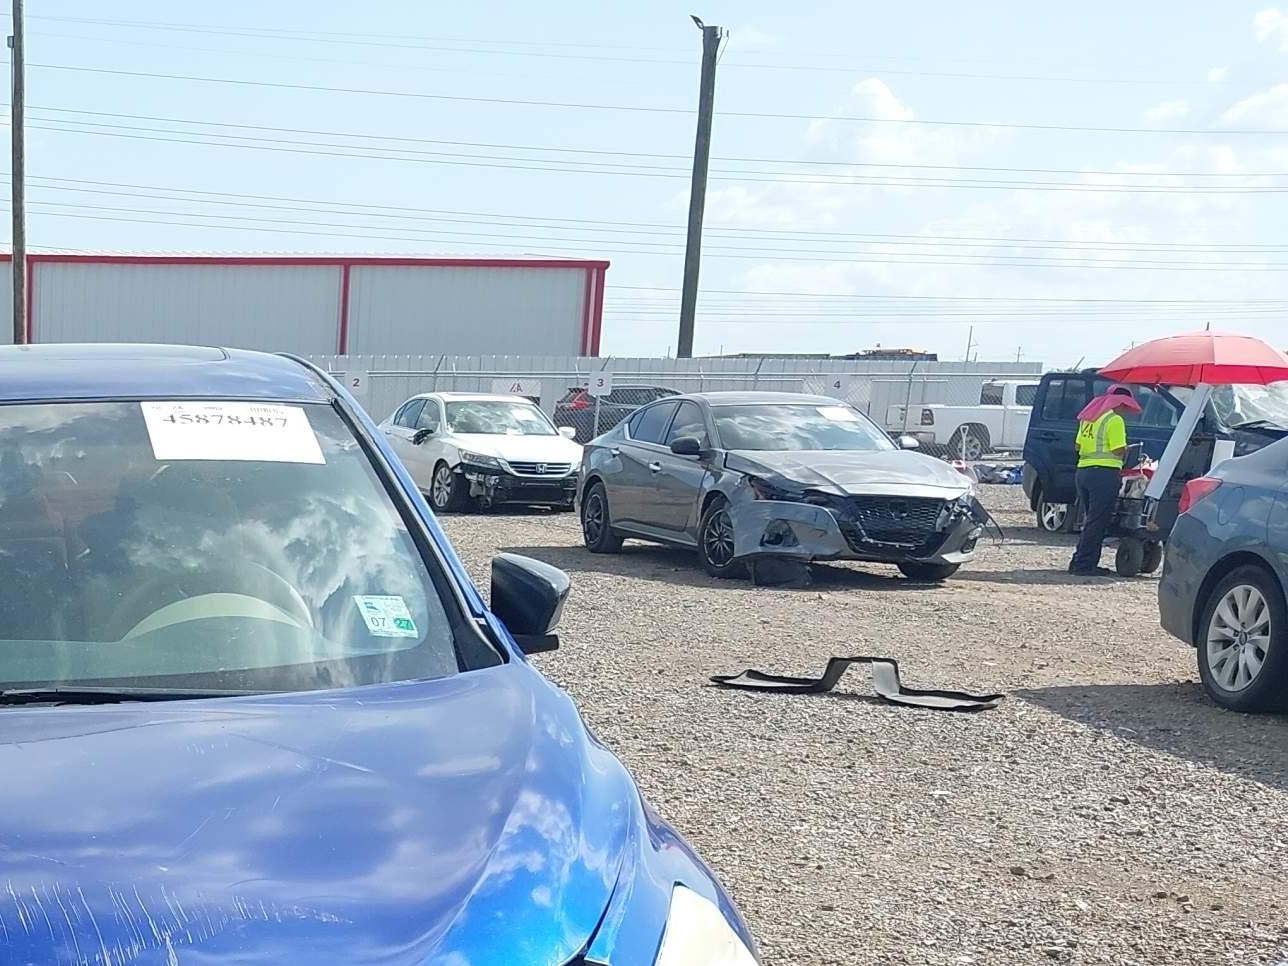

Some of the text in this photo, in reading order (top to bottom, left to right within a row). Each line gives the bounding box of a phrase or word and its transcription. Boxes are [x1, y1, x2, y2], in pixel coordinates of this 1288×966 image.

[352, 378, 360, 387] 2
[597, 378, 604, 387] 3
[833, 381, 841, 389] 4
[162, 414, 288, 427] 45878487
[371, 617, 385, 627] 07
